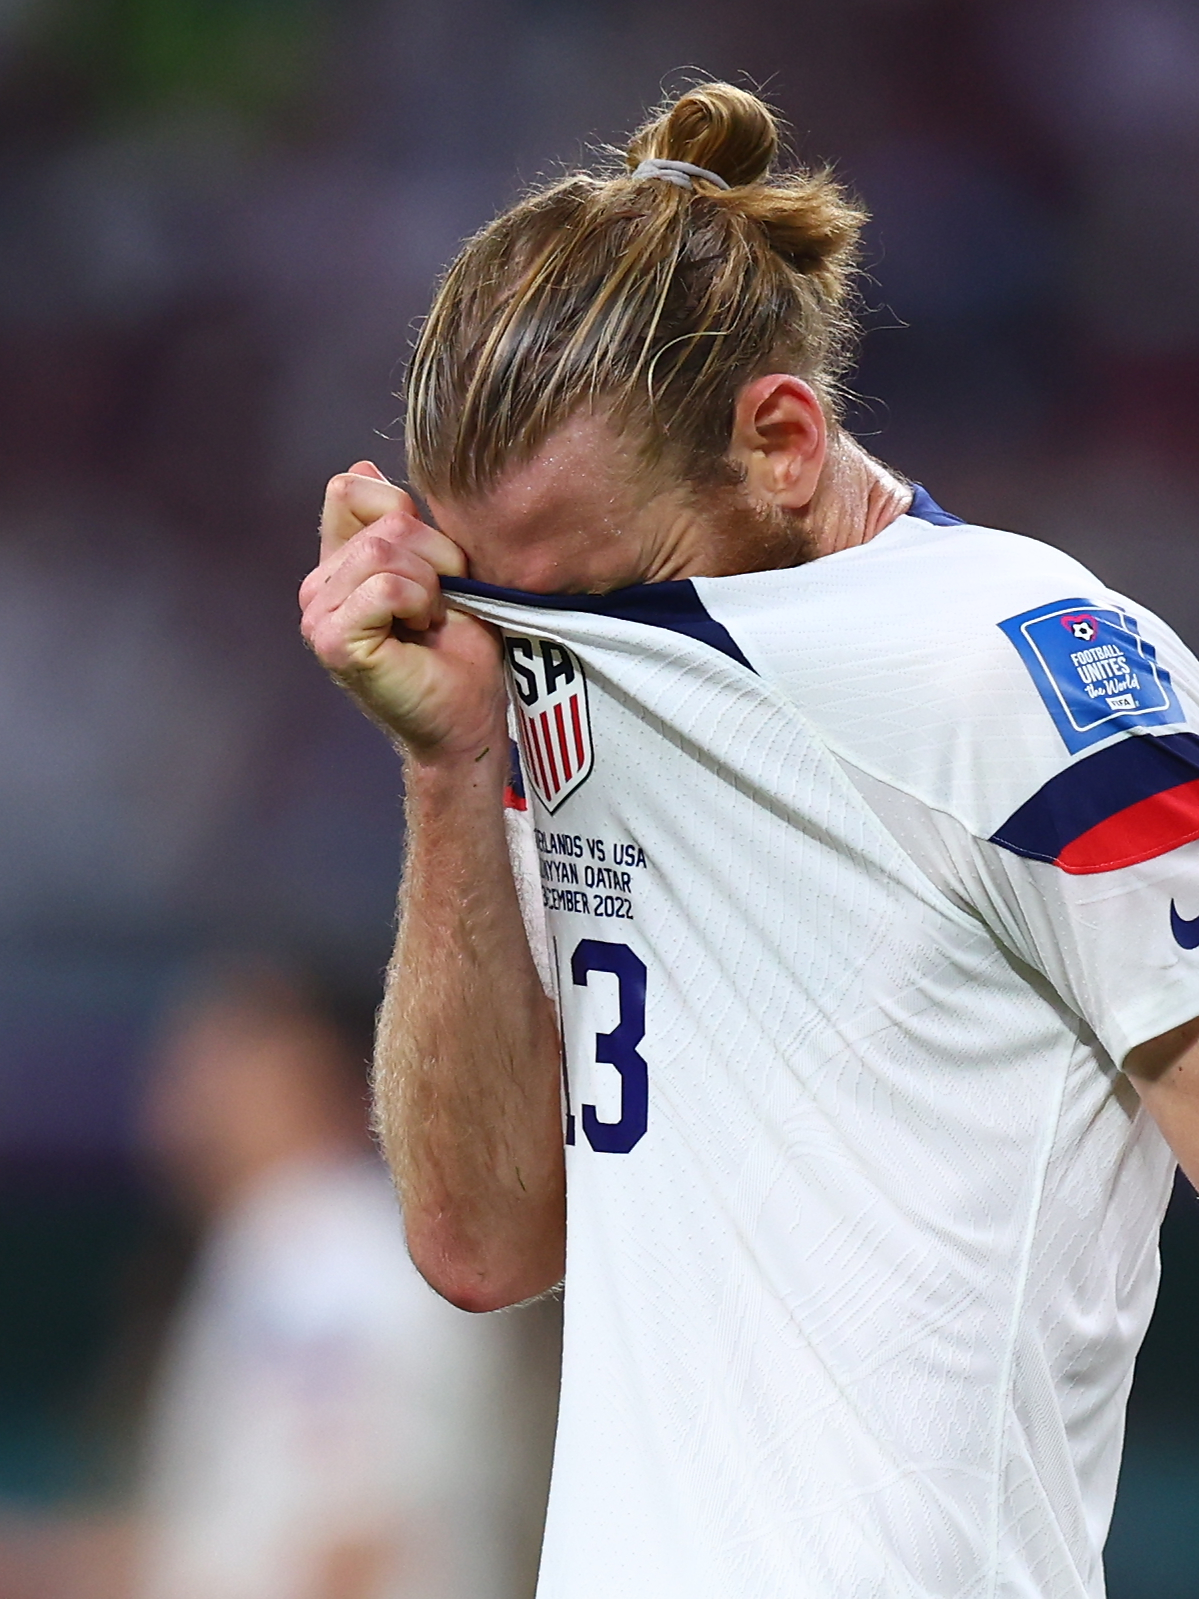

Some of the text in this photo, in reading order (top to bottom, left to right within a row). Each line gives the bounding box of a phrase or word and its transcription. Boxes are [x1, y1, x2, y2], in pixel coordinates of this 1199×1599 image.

[1070, 644, 1124, 667] FOOTBALL
[505, 636, 576, 707] SA
[1076, 656, 1131, 684] UNITES
[1084, 673, 1140, 699] the World
[1111, 698, 1131, 707] FIFA
[534, 827, 647, 869] RLANDS VS USA
[540, 858, 632, 893] AYYAN QATAR
[593, 894, 634, 920] 2022
[553, 936, 649, 1154] 3
